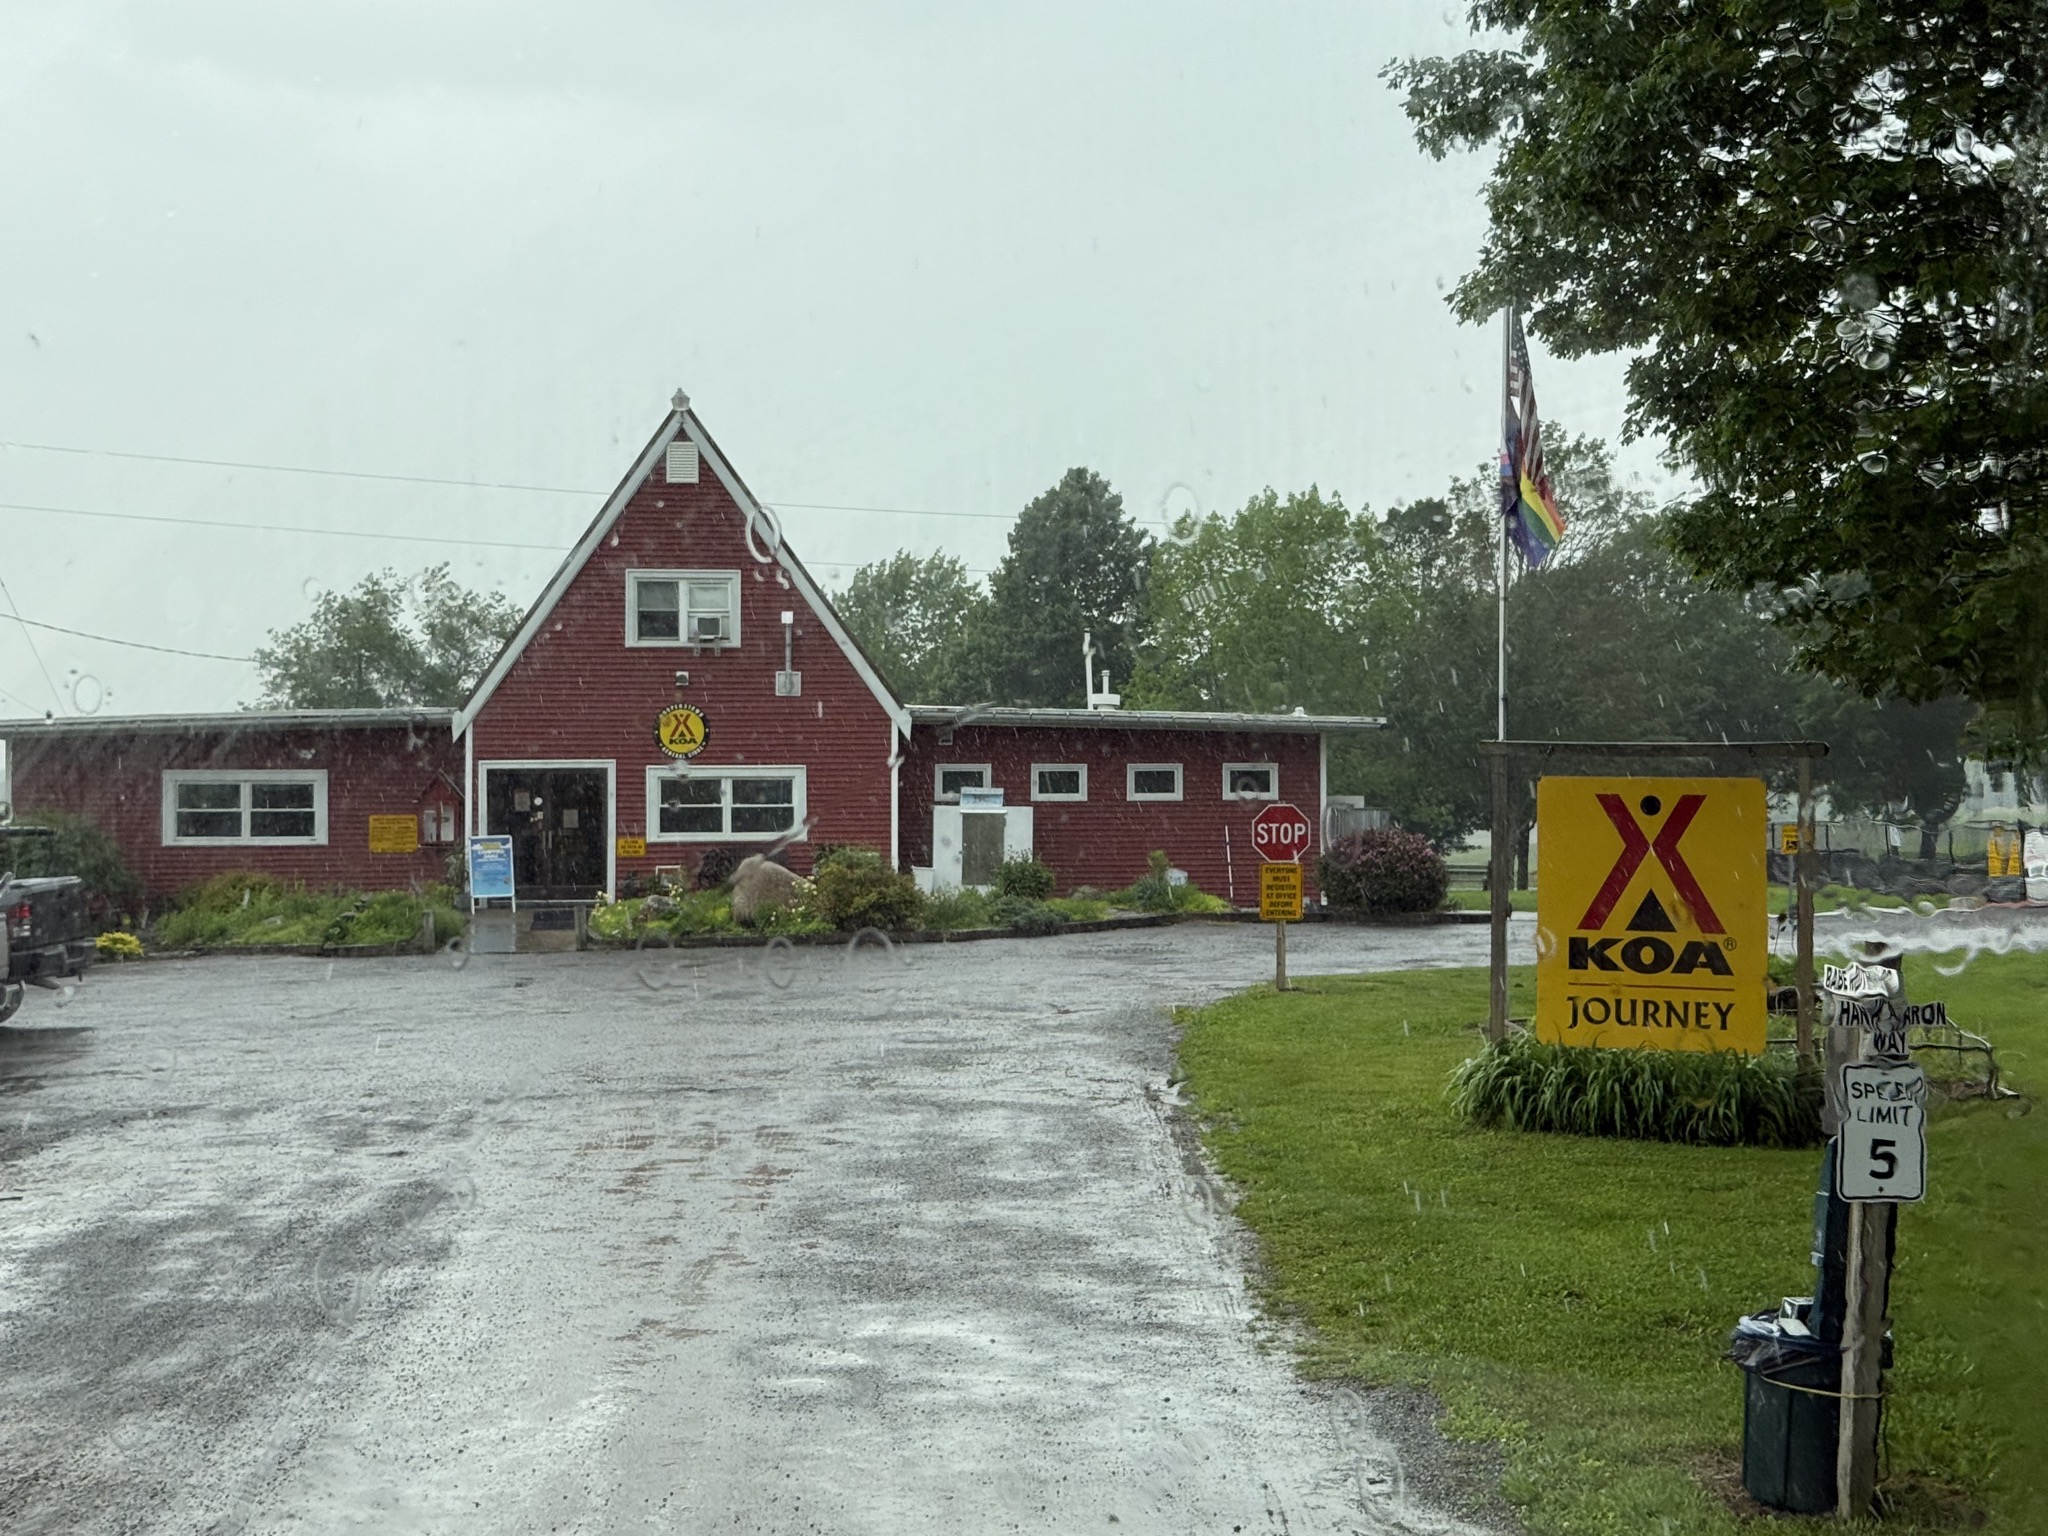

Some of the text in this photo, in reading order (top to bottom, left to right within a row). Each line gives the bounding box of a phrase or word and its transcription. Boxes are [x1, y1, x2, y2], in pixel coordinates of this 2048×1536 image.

[669, 737, 698, 745] KOA
[1257, 823, 1306, 844] STOP
[1568, 936, 1735, 977] KOA
[1826, 966, 1848, 990] BABE
[1566, 995, 1736, 1032] JOURNEY
[1874, 1031, 1906, 1054] WAY
[1857, 1105, 1913, 1127] LIMIT
[1869, 1138, 1897, 1179] 5
